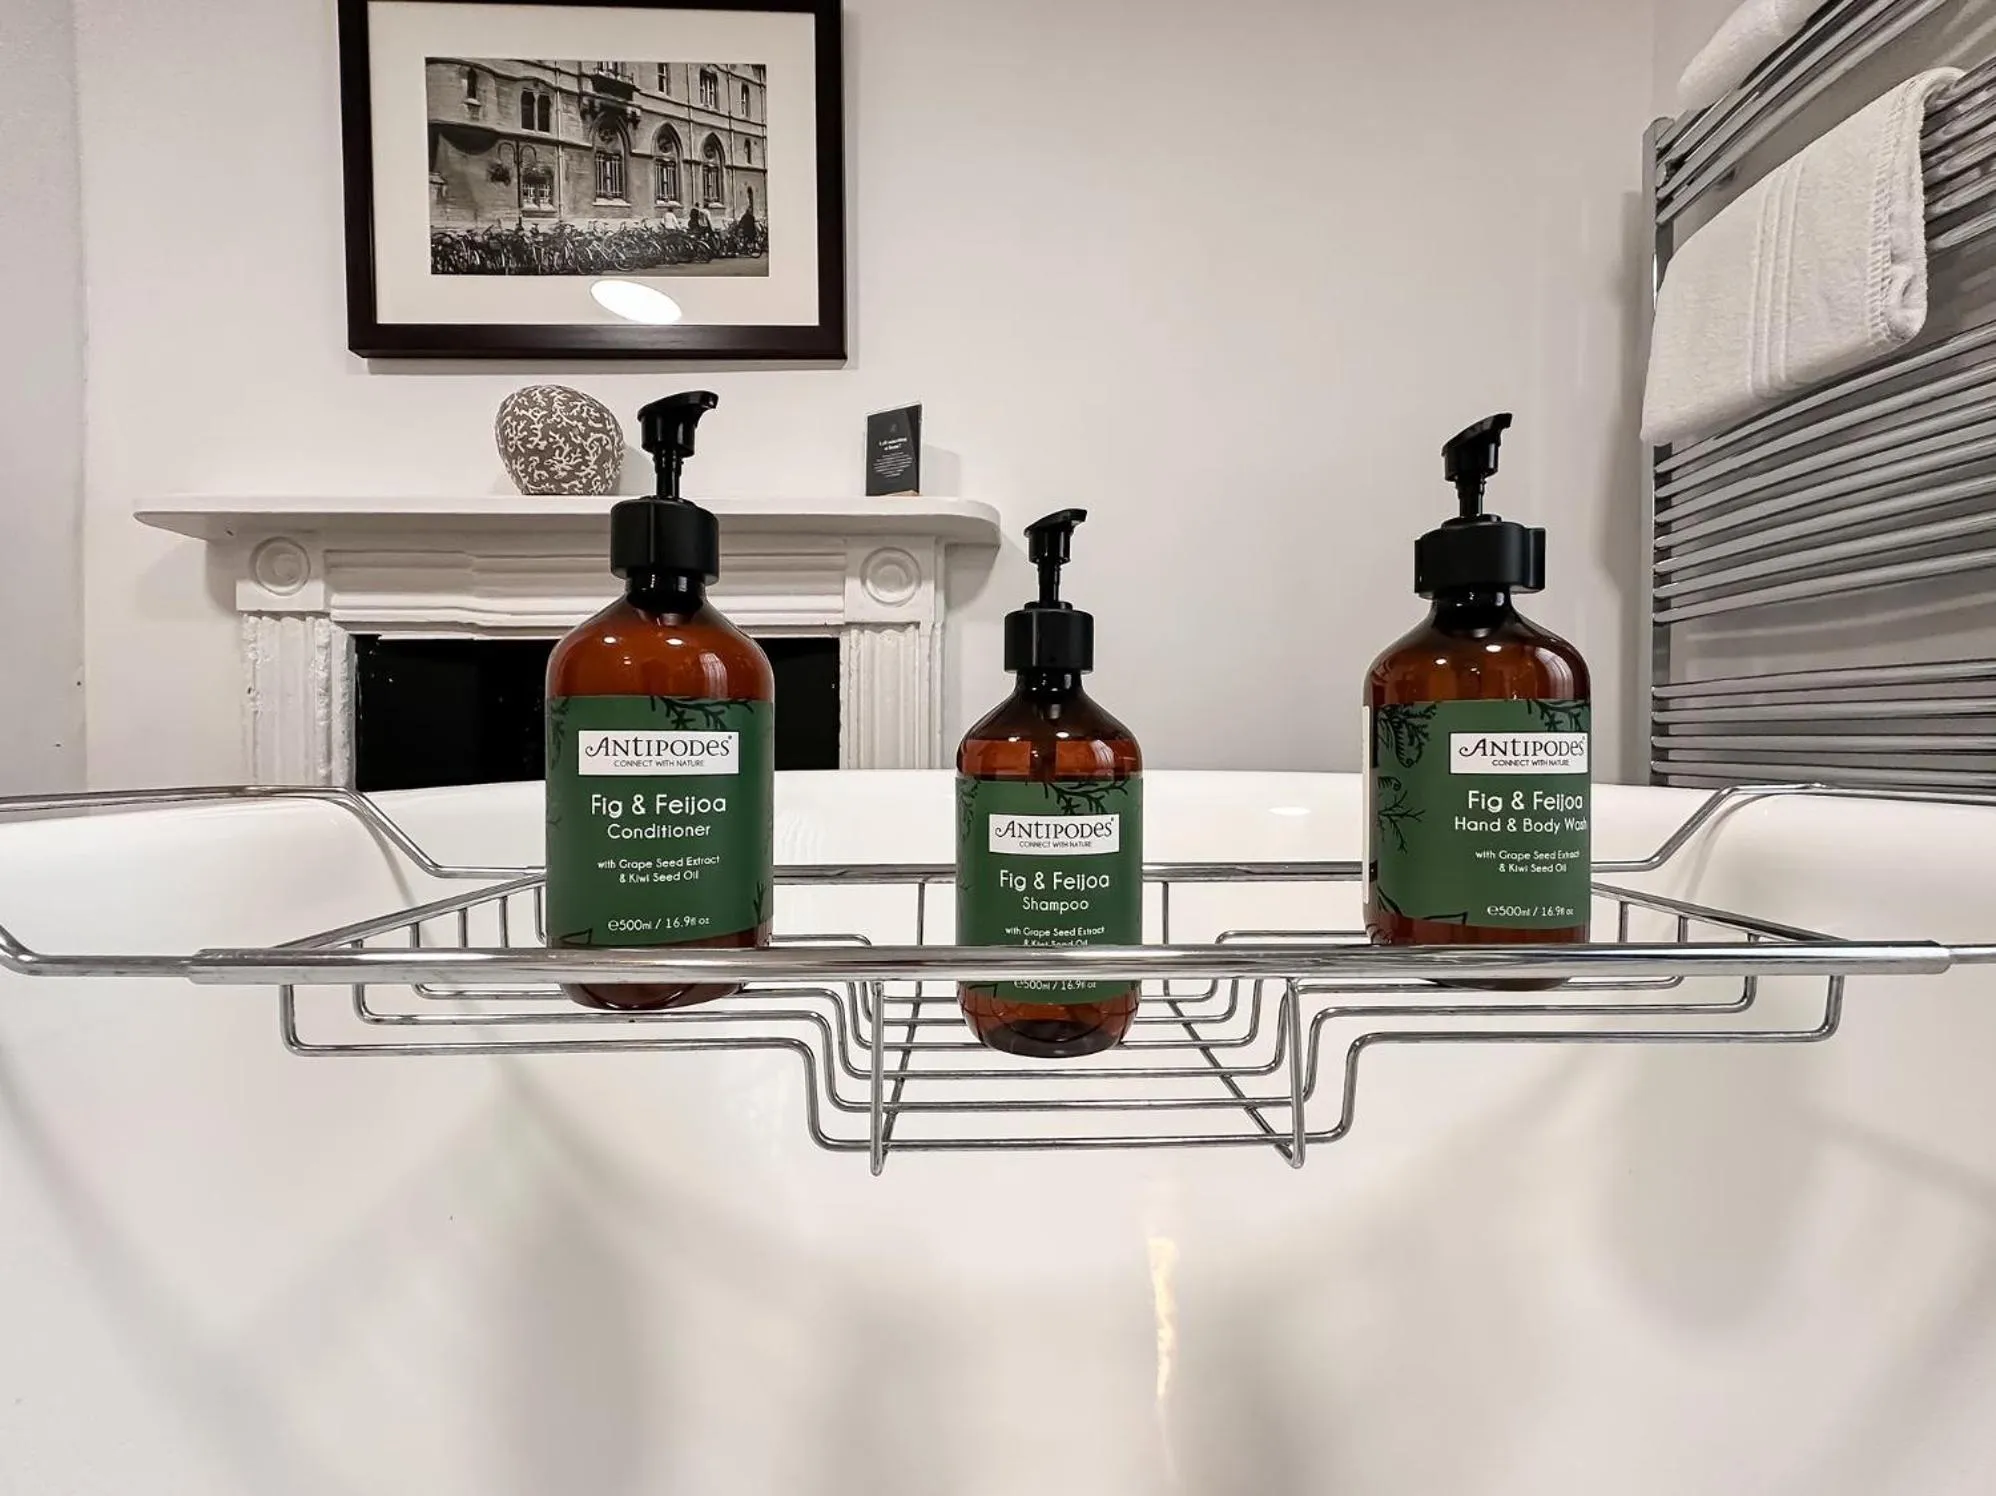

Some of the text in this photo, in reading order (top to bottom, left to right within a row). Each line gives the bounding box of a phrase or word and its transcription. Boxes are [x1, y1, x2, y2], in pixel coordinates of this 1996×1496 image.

[614, 760, 704, 768] CONNECT WITH NATURE
[1492, 759, 1570, 767] CONNECT WITH NATURE
[591, 794, 726, 819] Fig & Feijoa
[1468, 790, 1583, 813] Fig & Feijoa
[607, 823, 711, 840] Conditioner
[1455, 816, 1500, 832] Hand
[1507, 817, 1517, 832] &
[1523, 817, 1560, 834] Body
[597, 855, 720, 871] with Grape Seed Extract
[1475, 850, 1496, 860] with
[1499, 850, 1531, 861] Grape
[1534, 850, 1556, 860] Seed
[1499, 863, 1567, 873] & Kiwi Seed Oil
[619, 870, 699, 883] & Kiwi Seed Oil
[1000, 869, 1110, 892] Fig & Feijoa
[1022, 896, 1089, 915] Shampoo
[1005, 926, 1105, 938] with Grape Seed Extract
